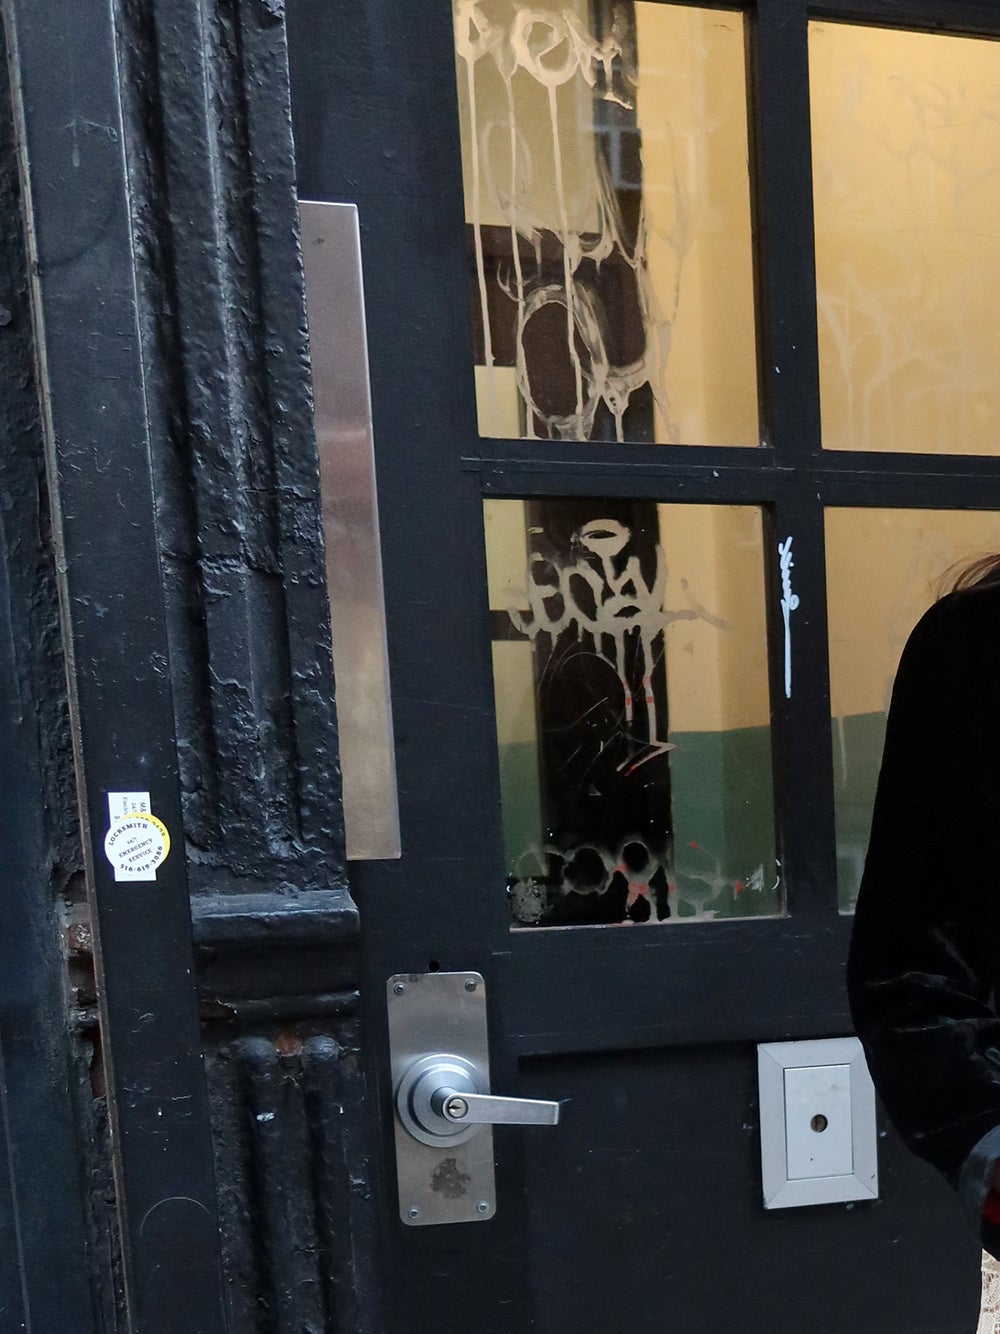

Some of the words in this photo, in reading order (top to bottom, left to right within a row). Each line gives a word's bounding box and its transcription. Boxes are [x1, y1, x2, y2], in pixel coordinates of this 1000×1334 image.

[108, 823, 148, 846] LOCKSMITH
[118, 837, 153, 858] EMERGENCY
[128, 848, 152, 863] SERVICE
